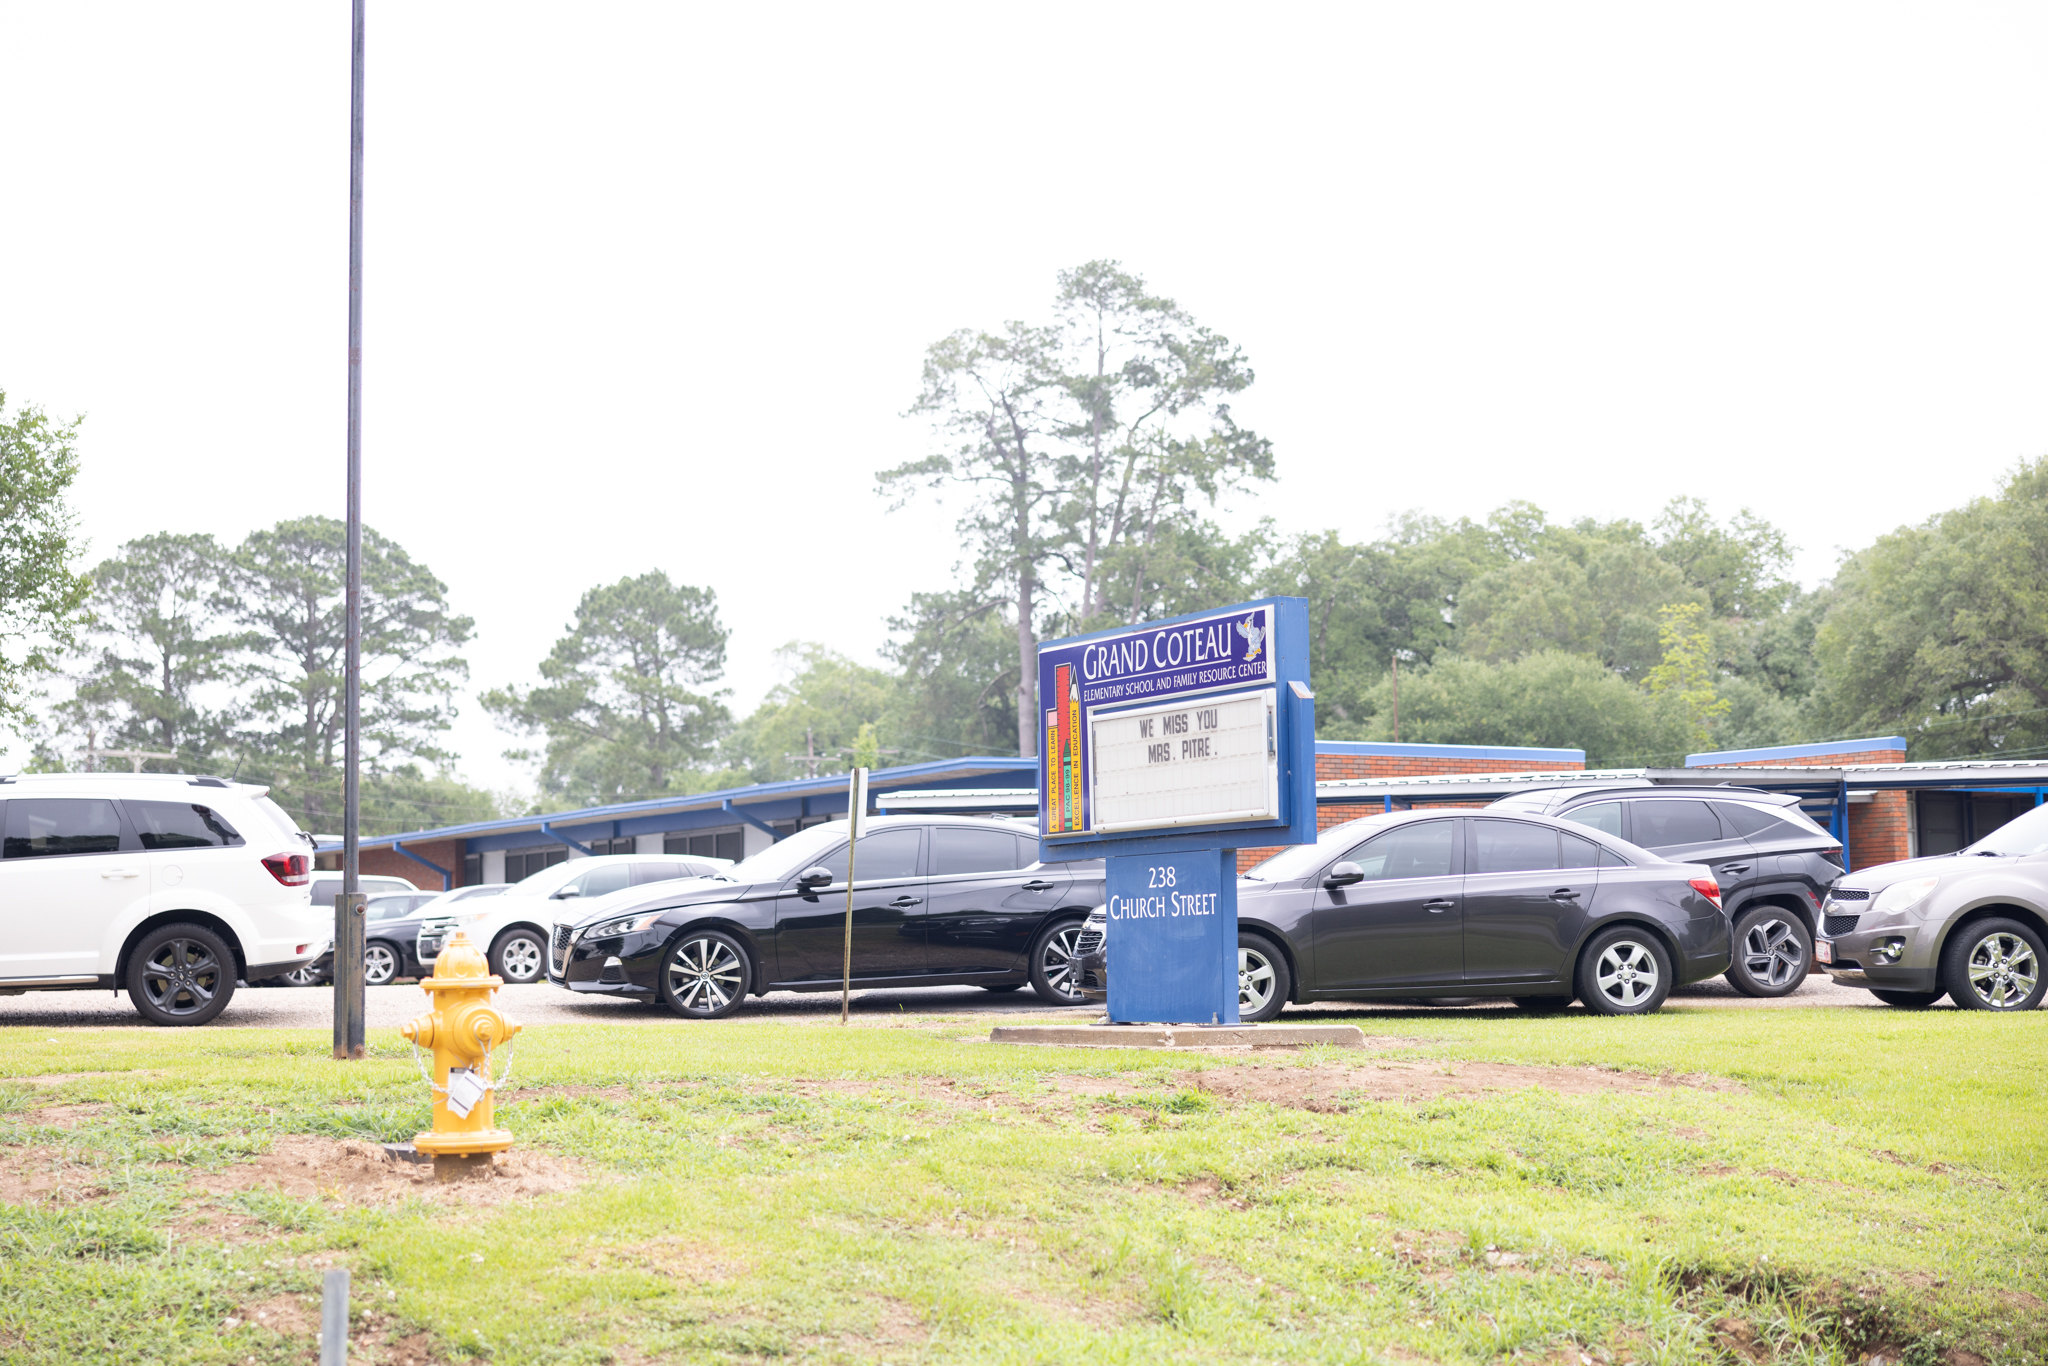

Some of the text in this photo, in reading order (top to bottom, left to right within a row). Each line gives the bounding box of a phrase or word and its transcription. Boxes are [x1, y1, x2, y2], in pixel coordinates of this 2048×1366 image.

[1083, 622, 1232, 680] GRAND COTEAU
[1084, 660, 1267, 702] ELEMENTARY SCHOOL AND FAMILY RESOURCE CENTER
[1139, 709, 1218, 738] WE MISS YOU
[1050, 757, 1056, 768] TO
[1073, 760, 1079, 769] IN
[1148, 742, 1175, 764] MRS.
[1148, 866, 1176, 889] 238
[1110, 891, 1217, 920] CHURCH STREET
